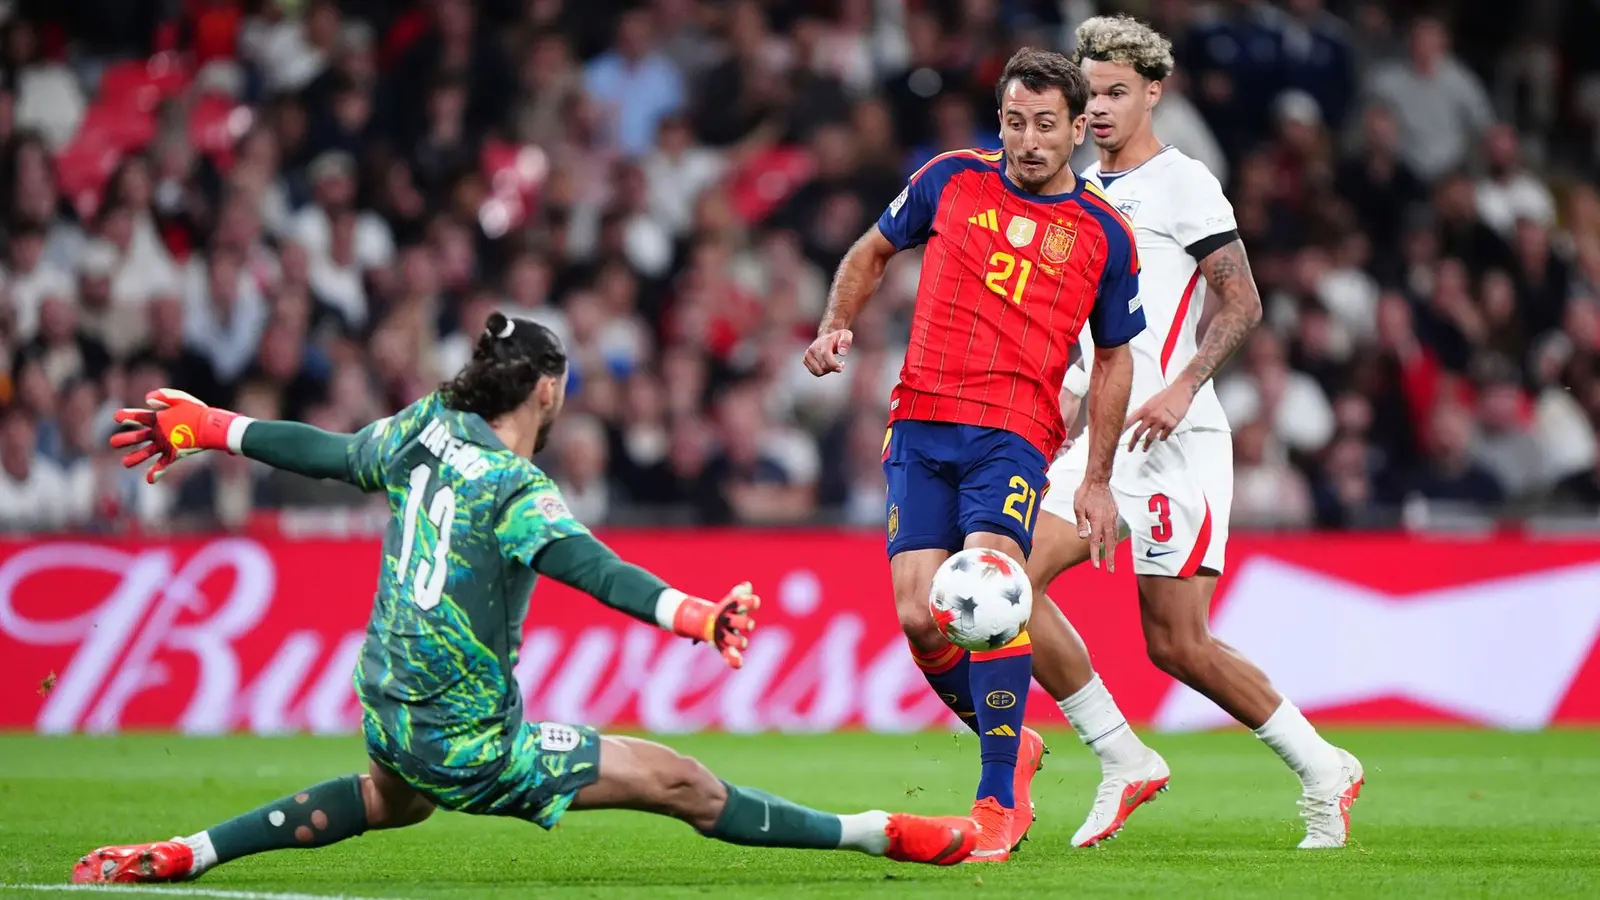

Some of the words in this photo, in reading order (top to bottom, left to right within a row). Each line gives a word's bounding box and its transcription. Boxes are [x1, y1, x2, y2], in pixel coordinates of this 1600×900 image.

[985, 251, 1033, 305] 21
[1002, 475, 1037, 533] 21
[1147, 493, 1173, 543] 3
[396, 462, 456, 612] 13
[0, 537, 1042, 735] Buweise
